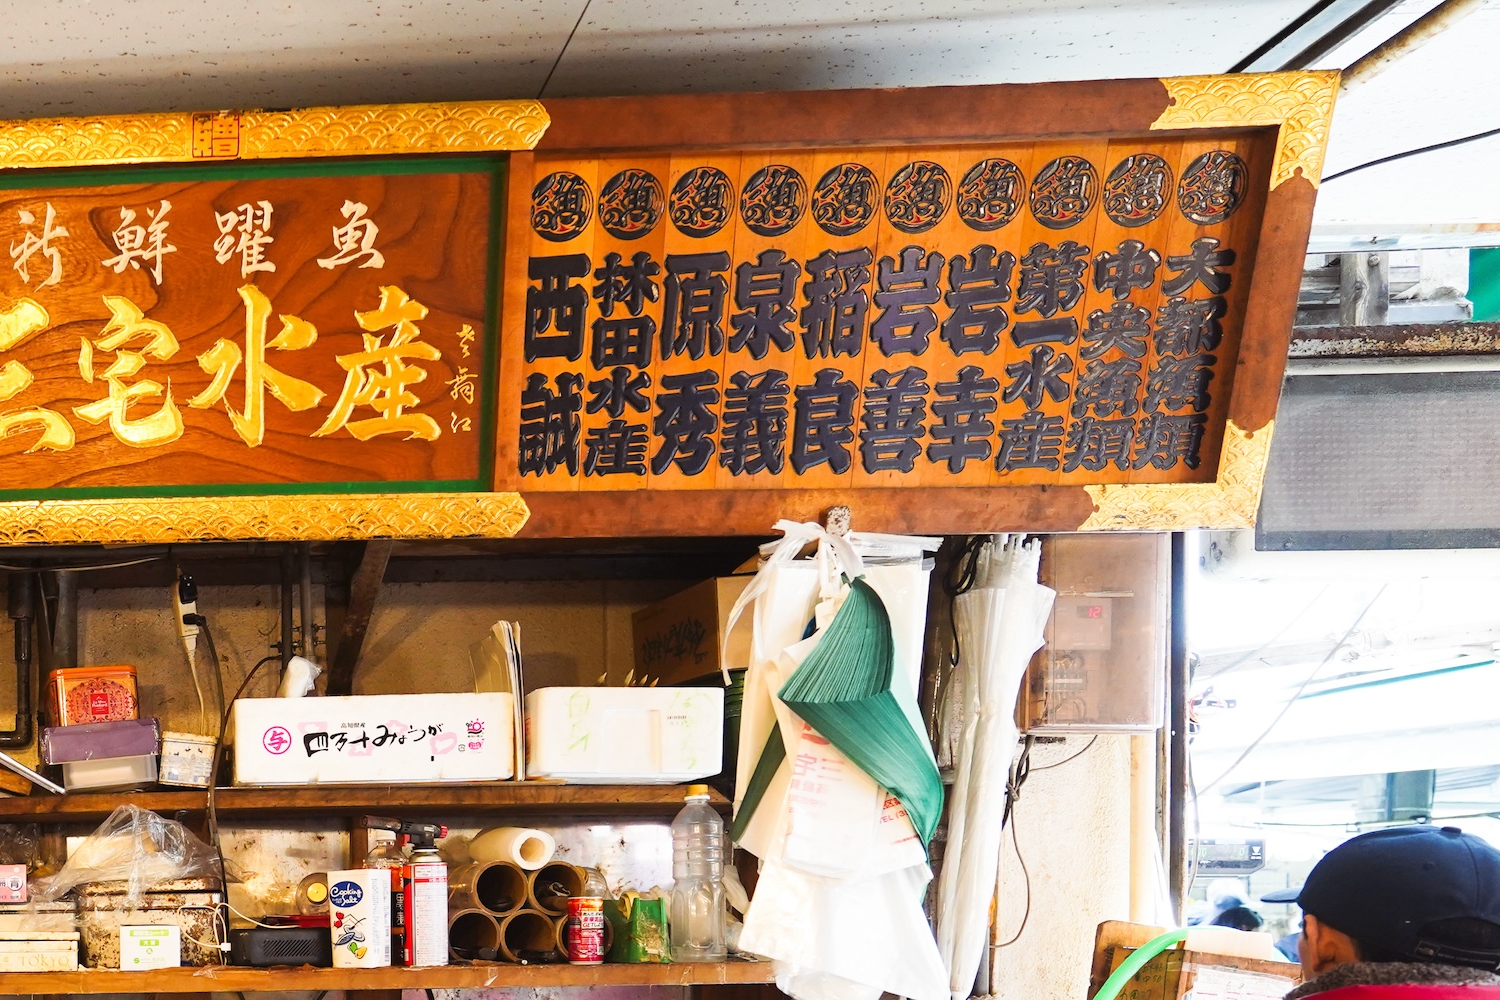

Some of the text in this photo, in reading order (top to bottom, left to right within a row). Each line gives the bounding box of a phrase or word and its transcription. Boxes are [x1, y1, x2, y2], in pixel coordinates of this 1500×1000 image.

[517, 252, 592, 478] 西誠
[649, 248, 732, 477] 原秀
[720, 248, 803, 478] 泉義
[856, 244, 943, 476] 岩善
[926, 243, 1014, 478] 岩幸
[994, 240, 1092, 473] 第一水産
[1063, 238, 1162, 473] 中央魚類
[1133, 237, 1237, 473] 大都魚類
[265, 729, 290, 753] 与
[9, 877, 20, 889] 青
[20, 956, 70, 967] TOKYO
[330, 883, 362, 897] Cooking
[341, 895, 358, 906] Salt
